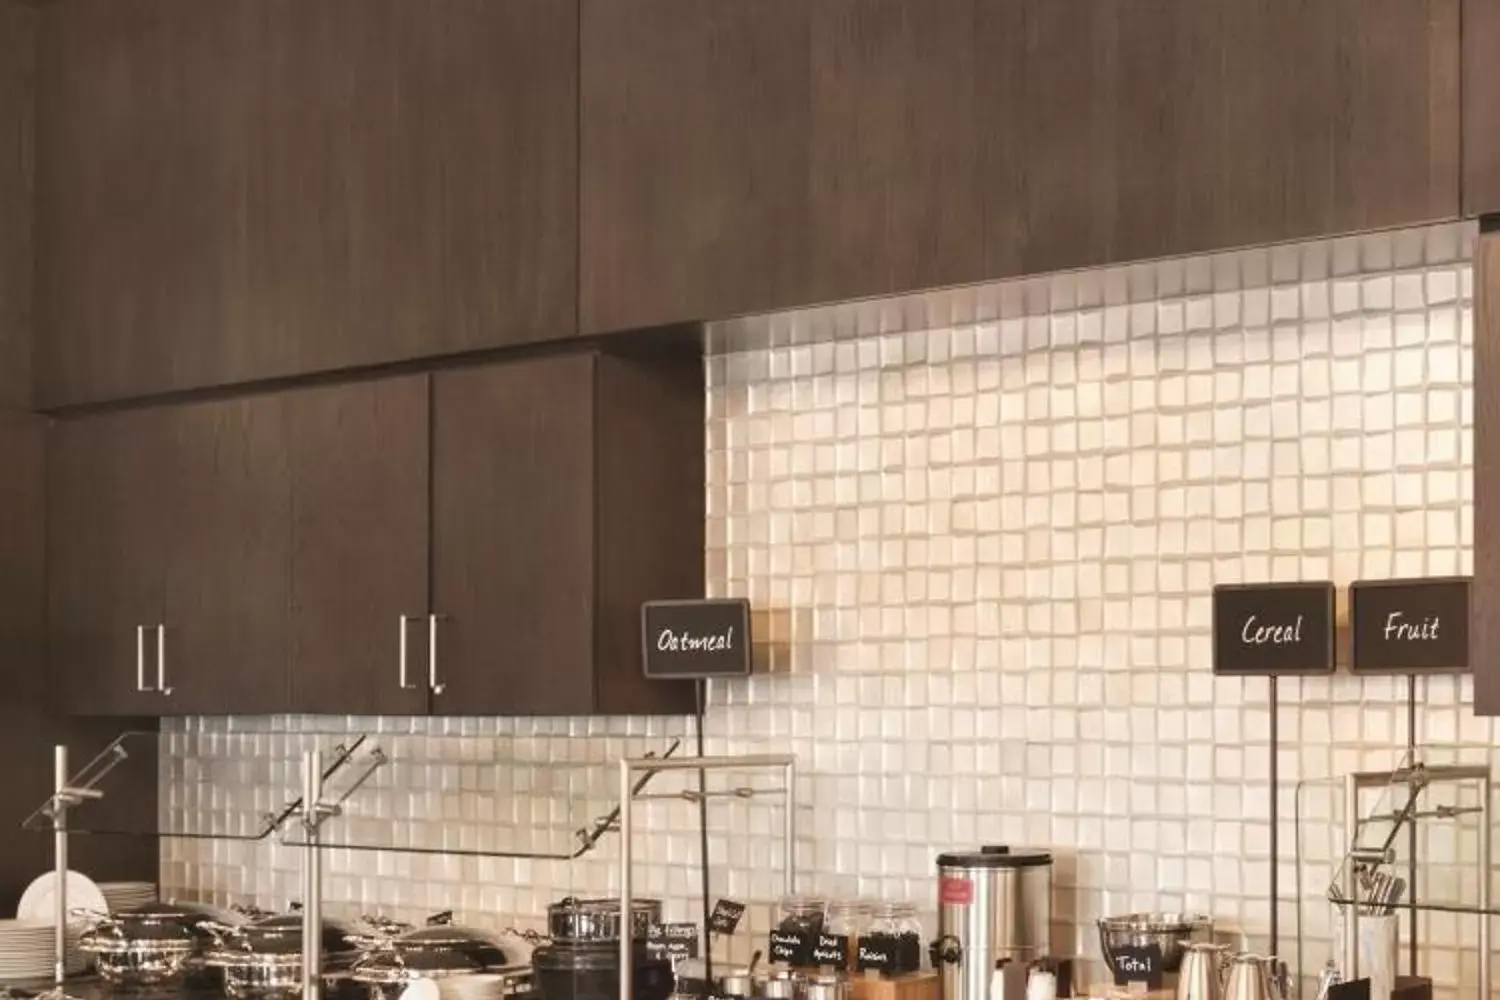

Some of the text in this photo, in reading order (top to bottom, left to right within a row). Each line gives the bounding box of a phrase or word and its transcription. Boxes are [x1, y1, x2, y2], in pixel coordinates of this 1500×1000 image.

[657, 625, 733, 651] Oatmeal
[1241, 615, 1303, 644] Cereal
[1384, 612, 1440, 640] Fruit
[859, 947, 888, 962] Raisins
[1115, 955, 1152, 973] Total
